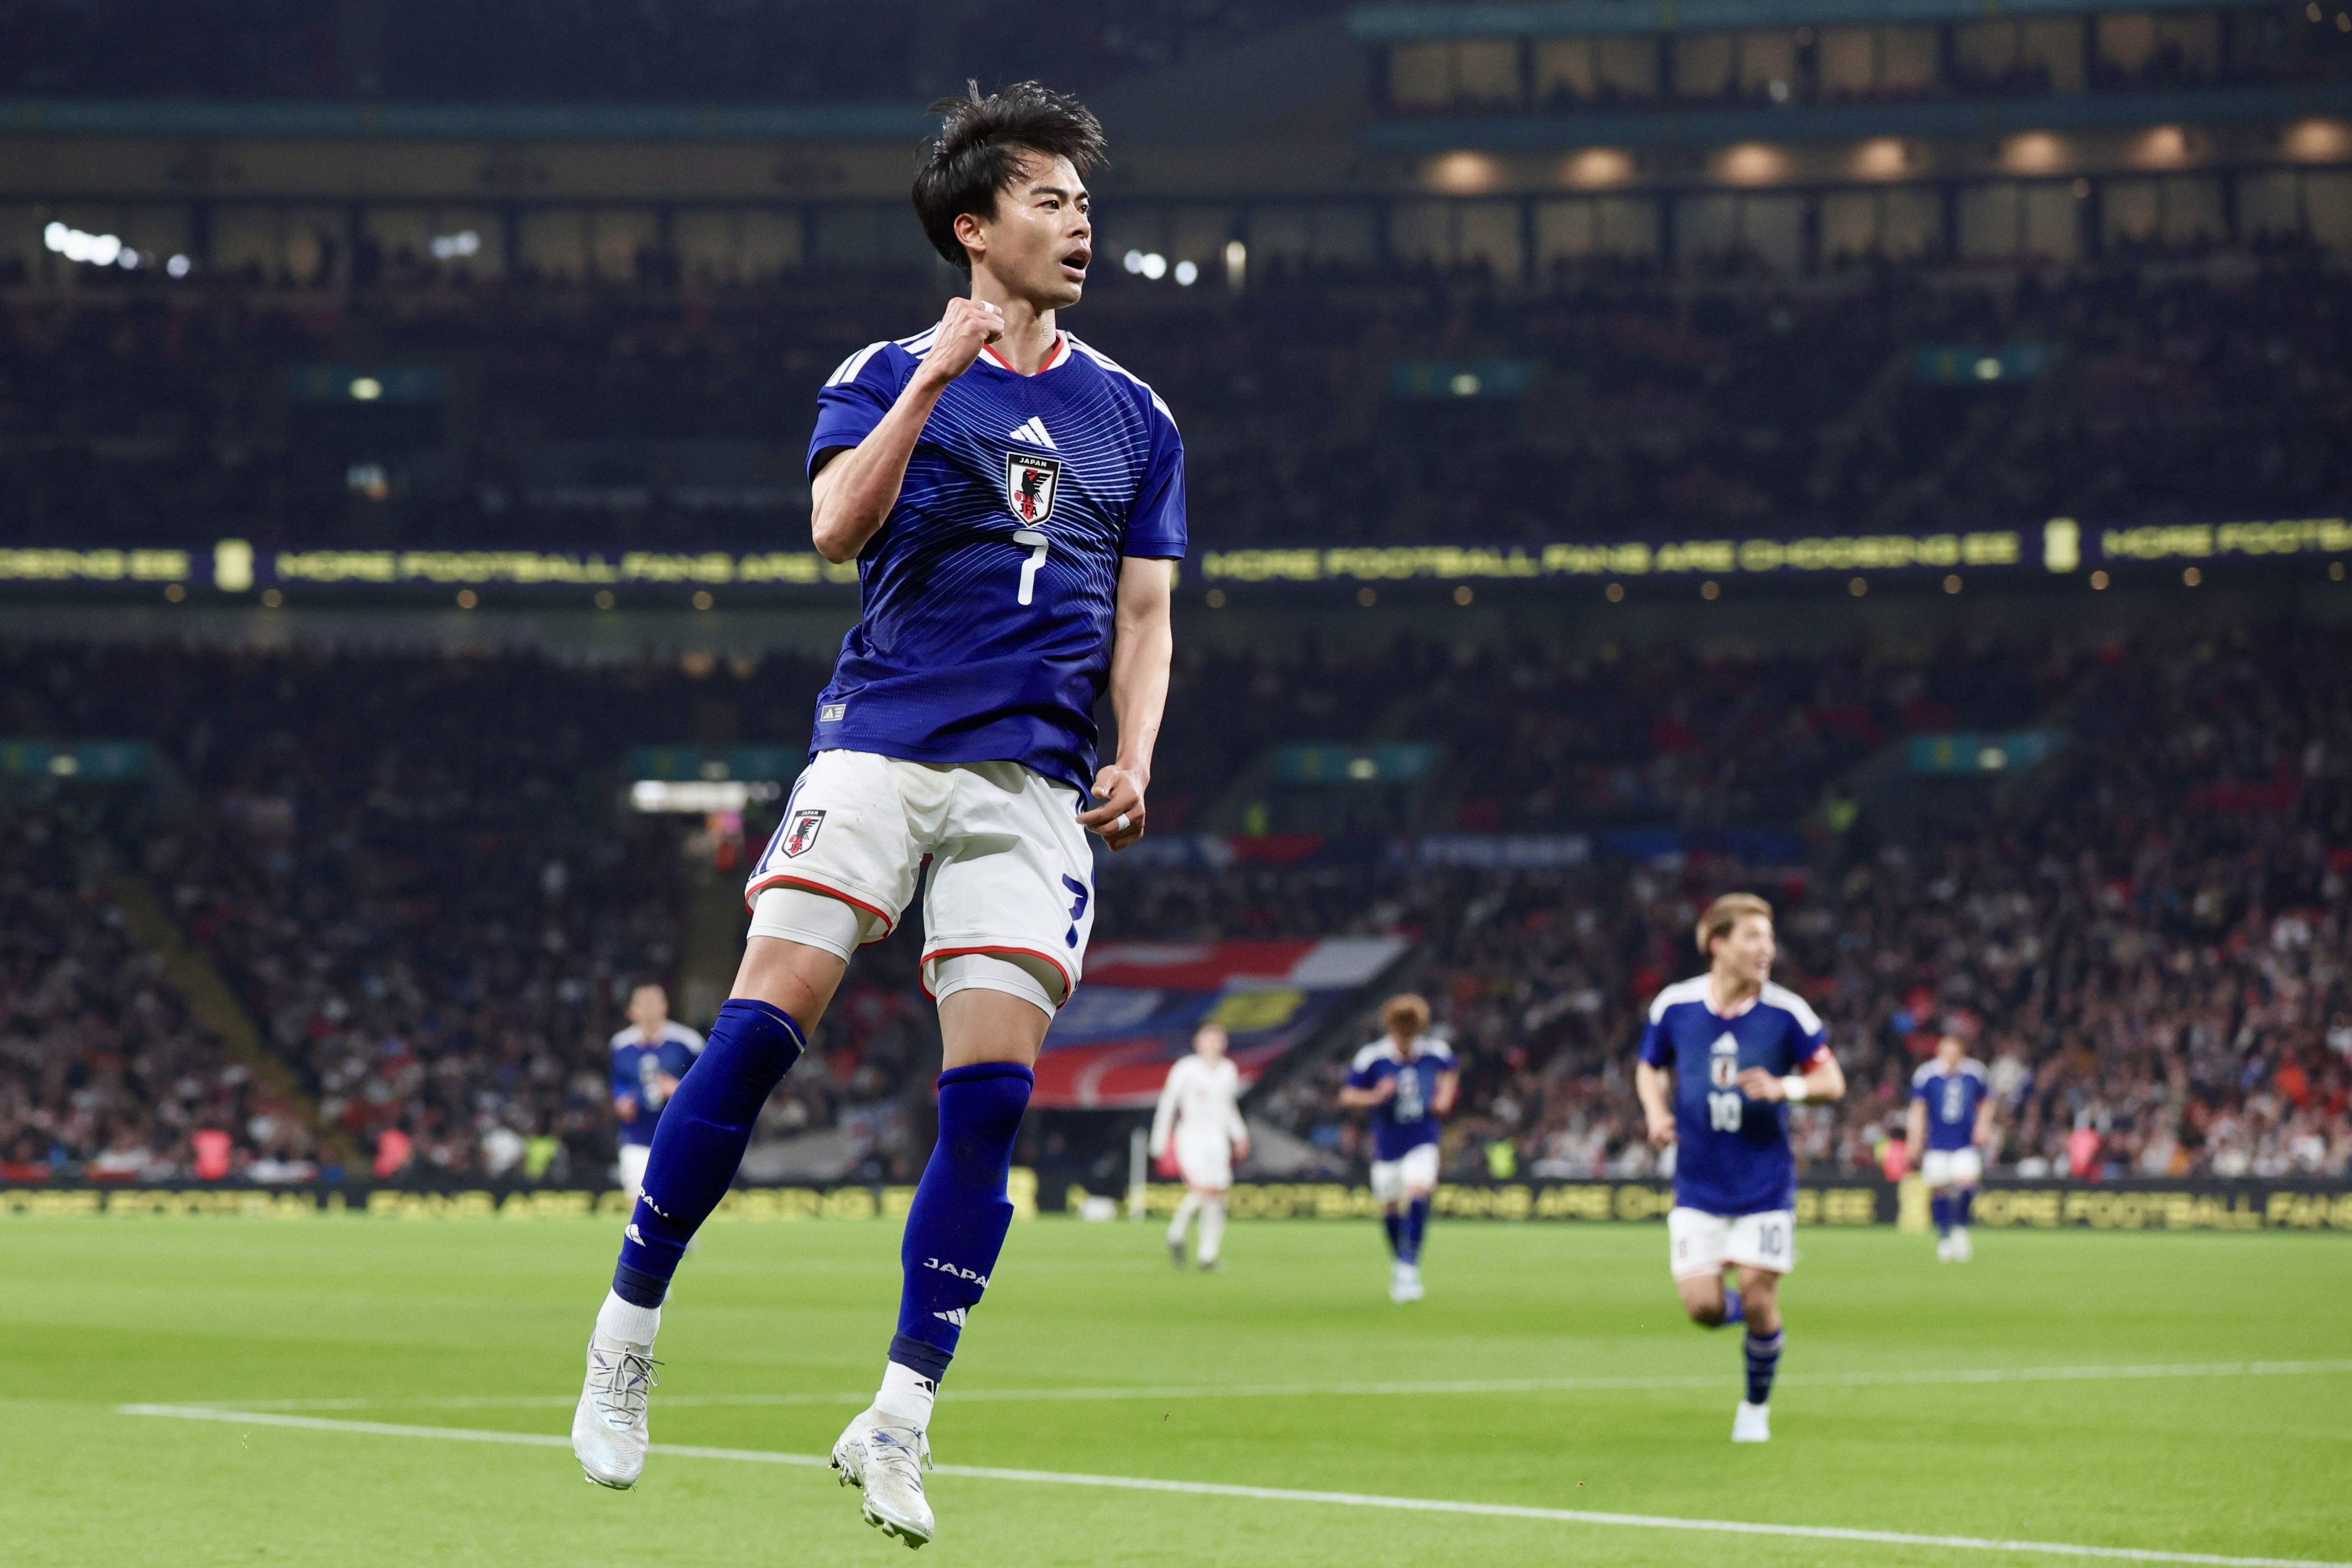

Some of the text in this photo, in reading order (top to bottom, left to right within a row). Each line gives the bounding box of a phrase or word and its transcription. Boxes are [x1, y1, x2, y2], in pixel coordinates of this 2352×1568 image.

[1019, 457, 1047, 467] JAPAN
[1019, 502, 1038, 517] JFA
[1012, 530, 1049, 606] 7
[1201, 548, 1320, 581] MORE
[1325, 545, 1541, 579] FOOTBALL
[1061, 872, 1089, 949] 7
[1707, 1091, 1743, 1133] 10
[2065, 1189, 2261, 1230] FOOTBALL
[1758, 1223, 1782, 1256] 10
